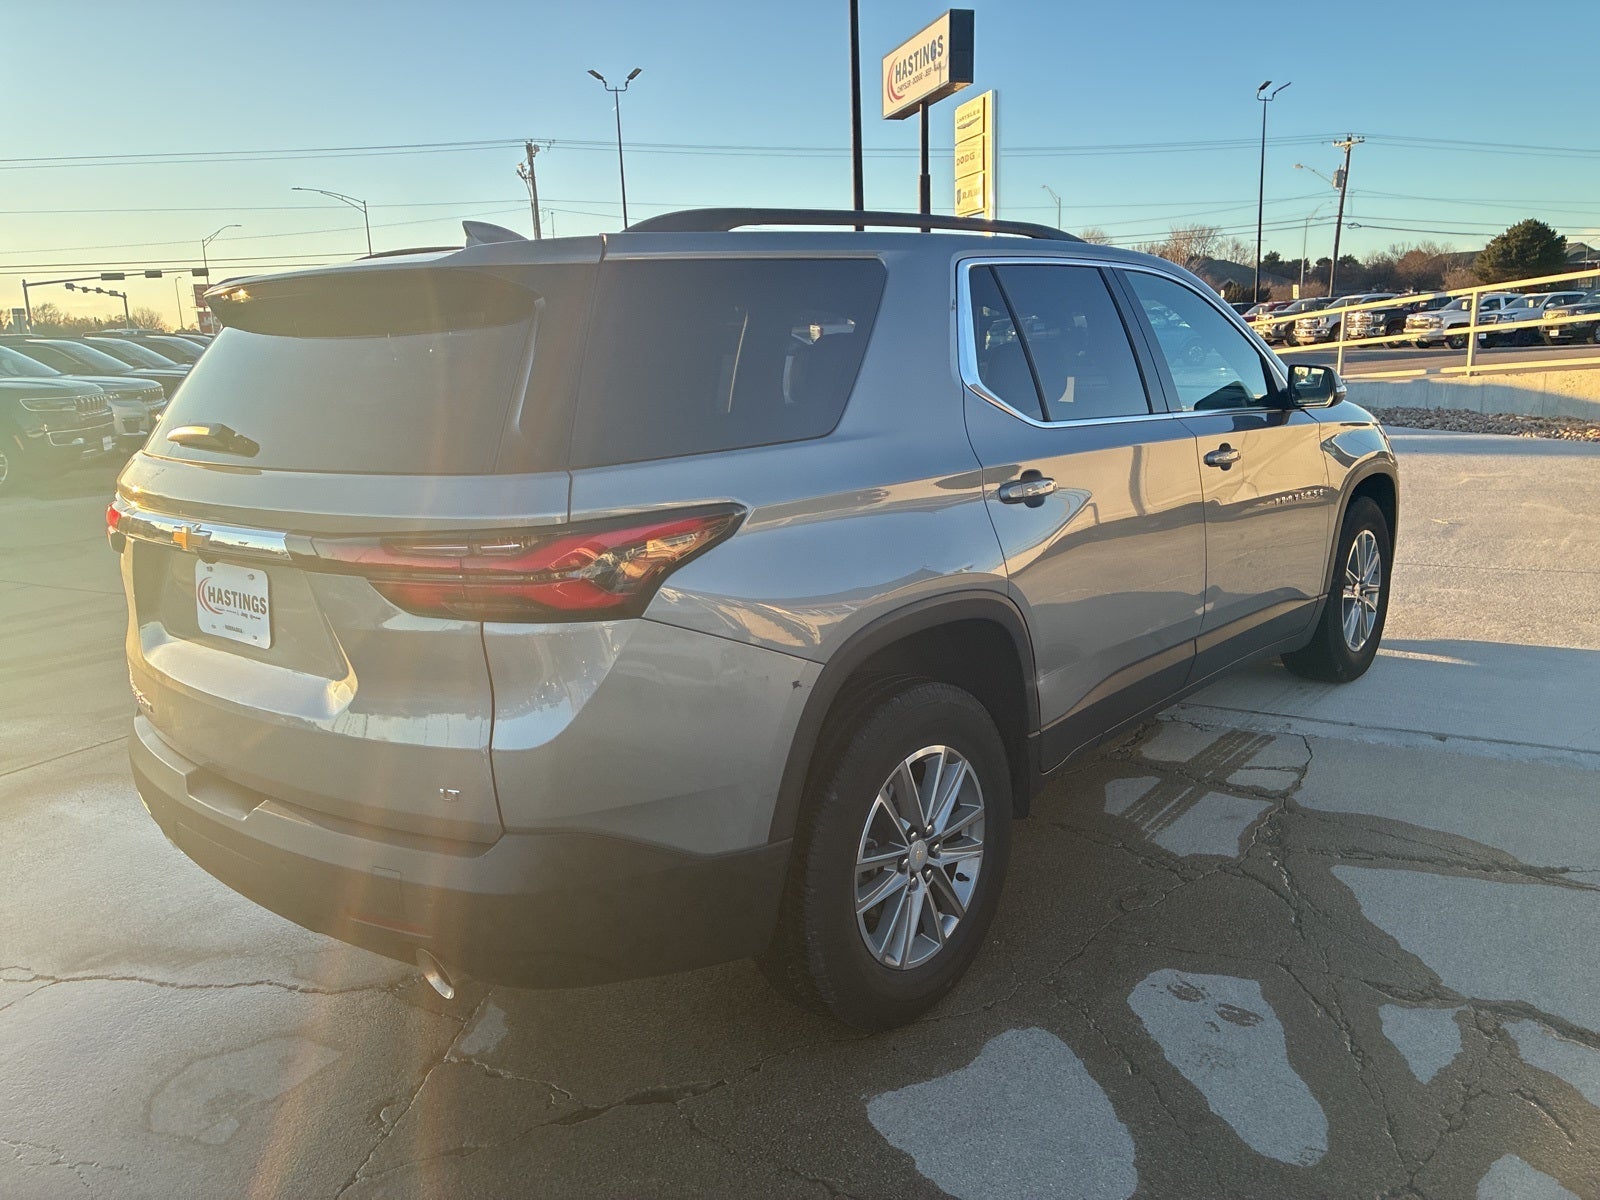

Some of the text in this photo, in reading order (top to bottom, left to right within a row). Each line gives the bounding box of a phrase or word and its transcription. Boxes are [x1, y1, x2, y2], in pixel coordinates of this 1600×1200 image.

[895, 34, 944, 84] HASTINGS
[956, 151, 980, 166] DODG
[207, 585, 267, 615] HASTINGS
